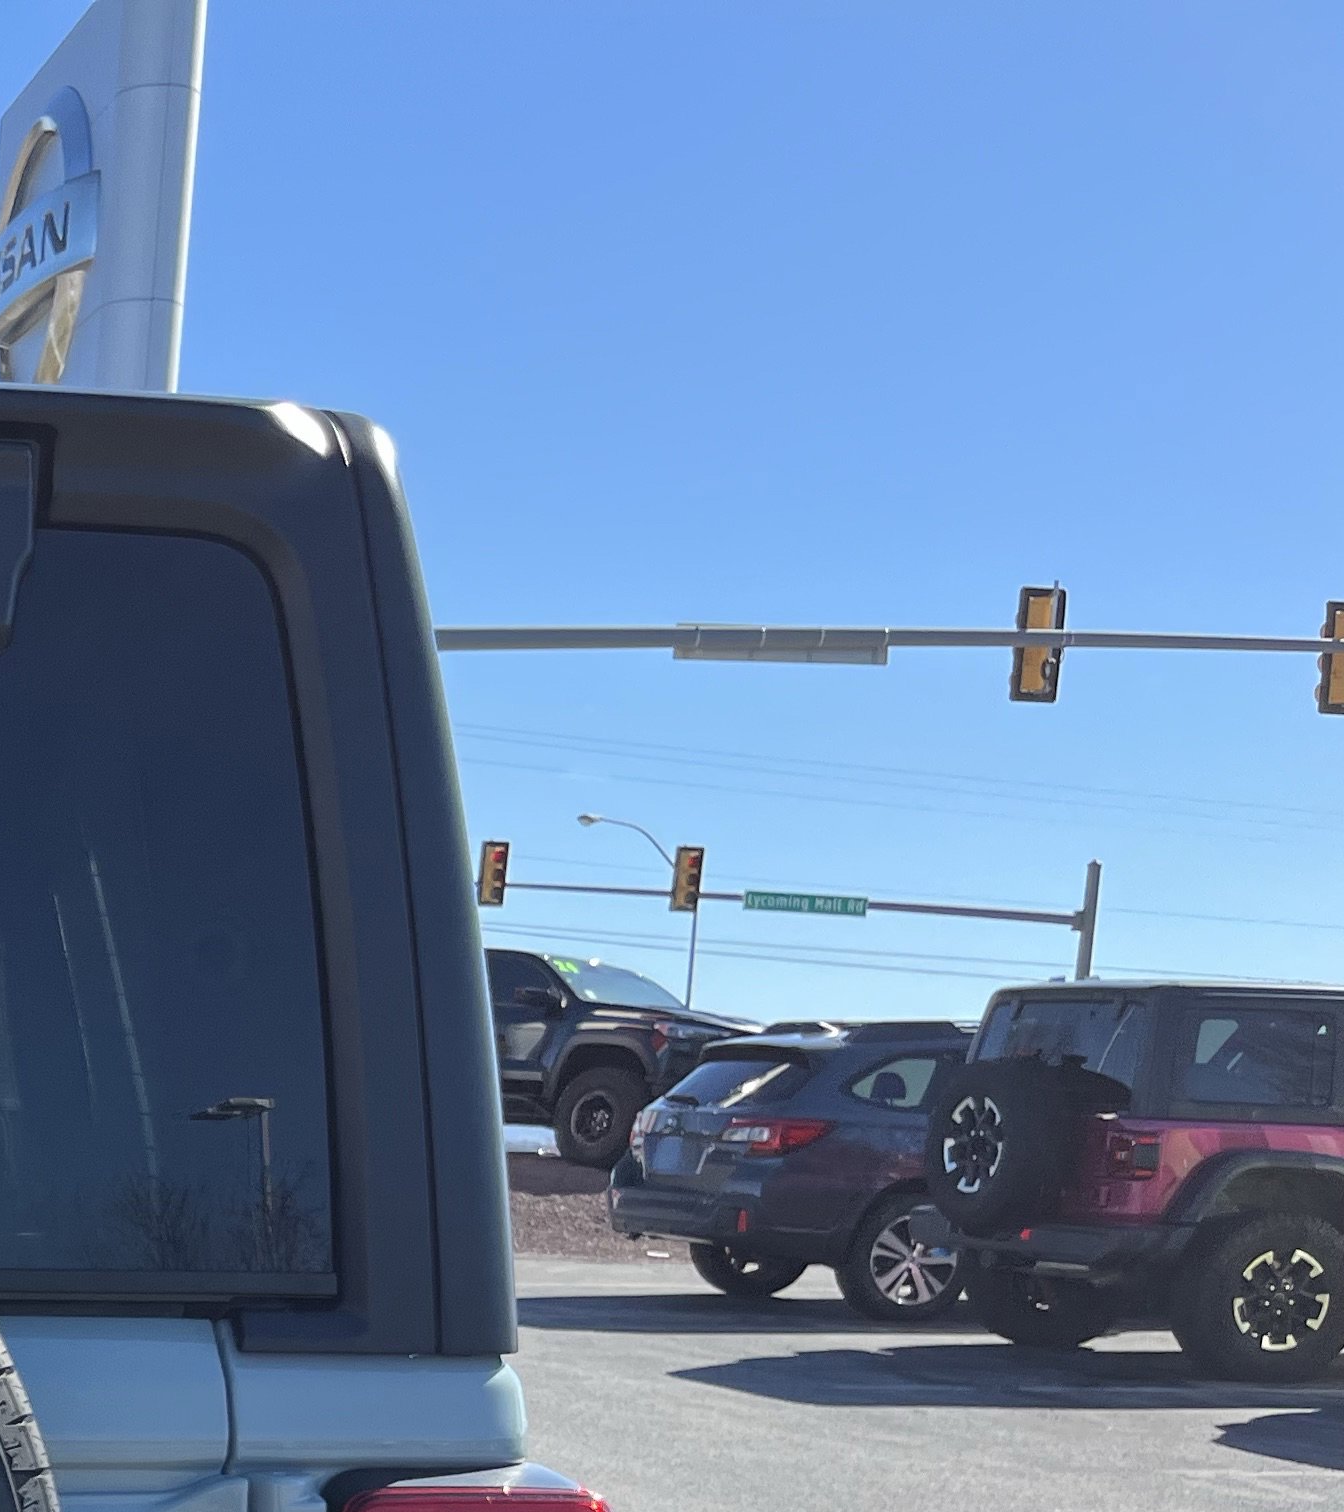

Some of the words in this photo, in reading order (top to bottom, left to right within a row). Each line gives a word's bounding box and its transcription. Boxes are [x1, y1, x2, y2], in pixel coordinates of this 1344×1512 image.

[747, 893, 809, 912] Lycoming
[814, 897, 842, 913] Mall
[847, 898, 863, 913] Rd
